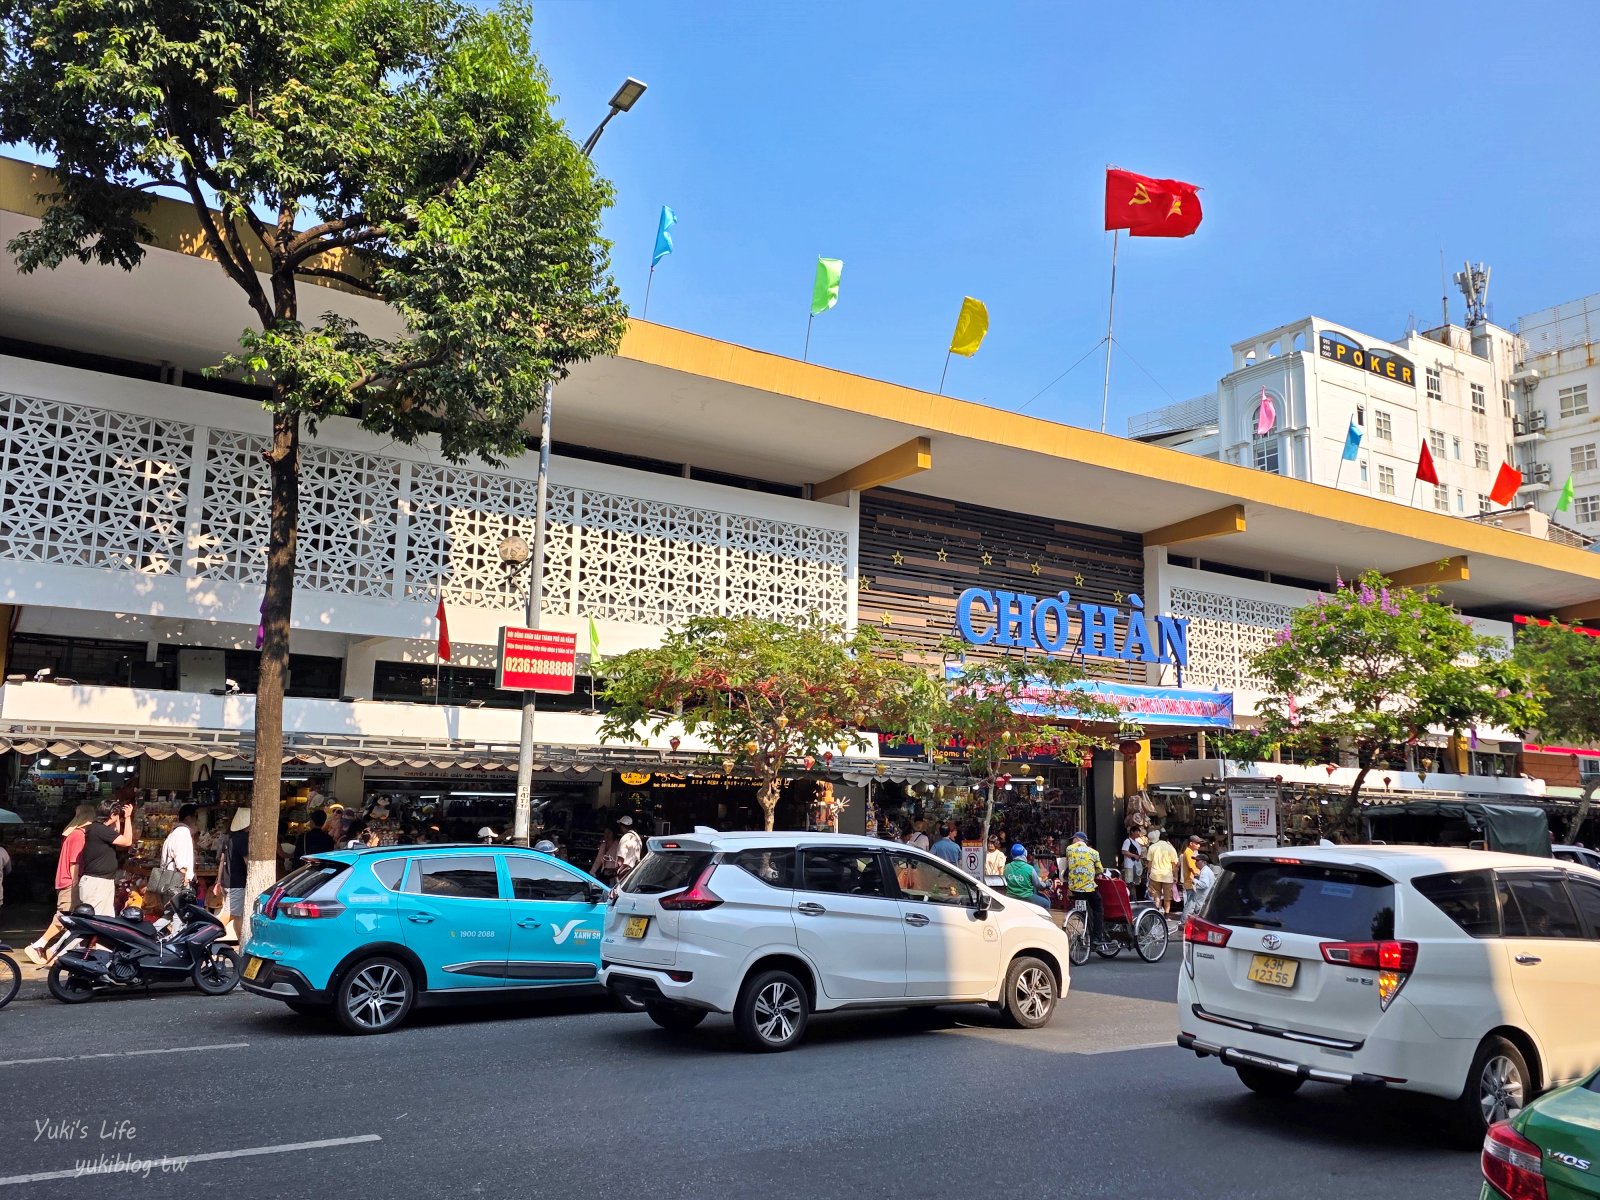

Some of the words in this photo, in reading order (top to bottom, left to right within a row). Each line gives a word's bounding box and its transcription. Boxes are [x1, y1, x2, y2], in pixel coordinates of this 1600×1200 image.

[1336, 344, 1411, 382] POKER
[1077, 593, 1189, 667] HÀN
[506, 656, 573, 676] 0236.3888888
[1008, 874, 1024, 882] Grab
[1264, 958, 1284, 972] 43H
[1254, 968, 1289, 984] 123.56
